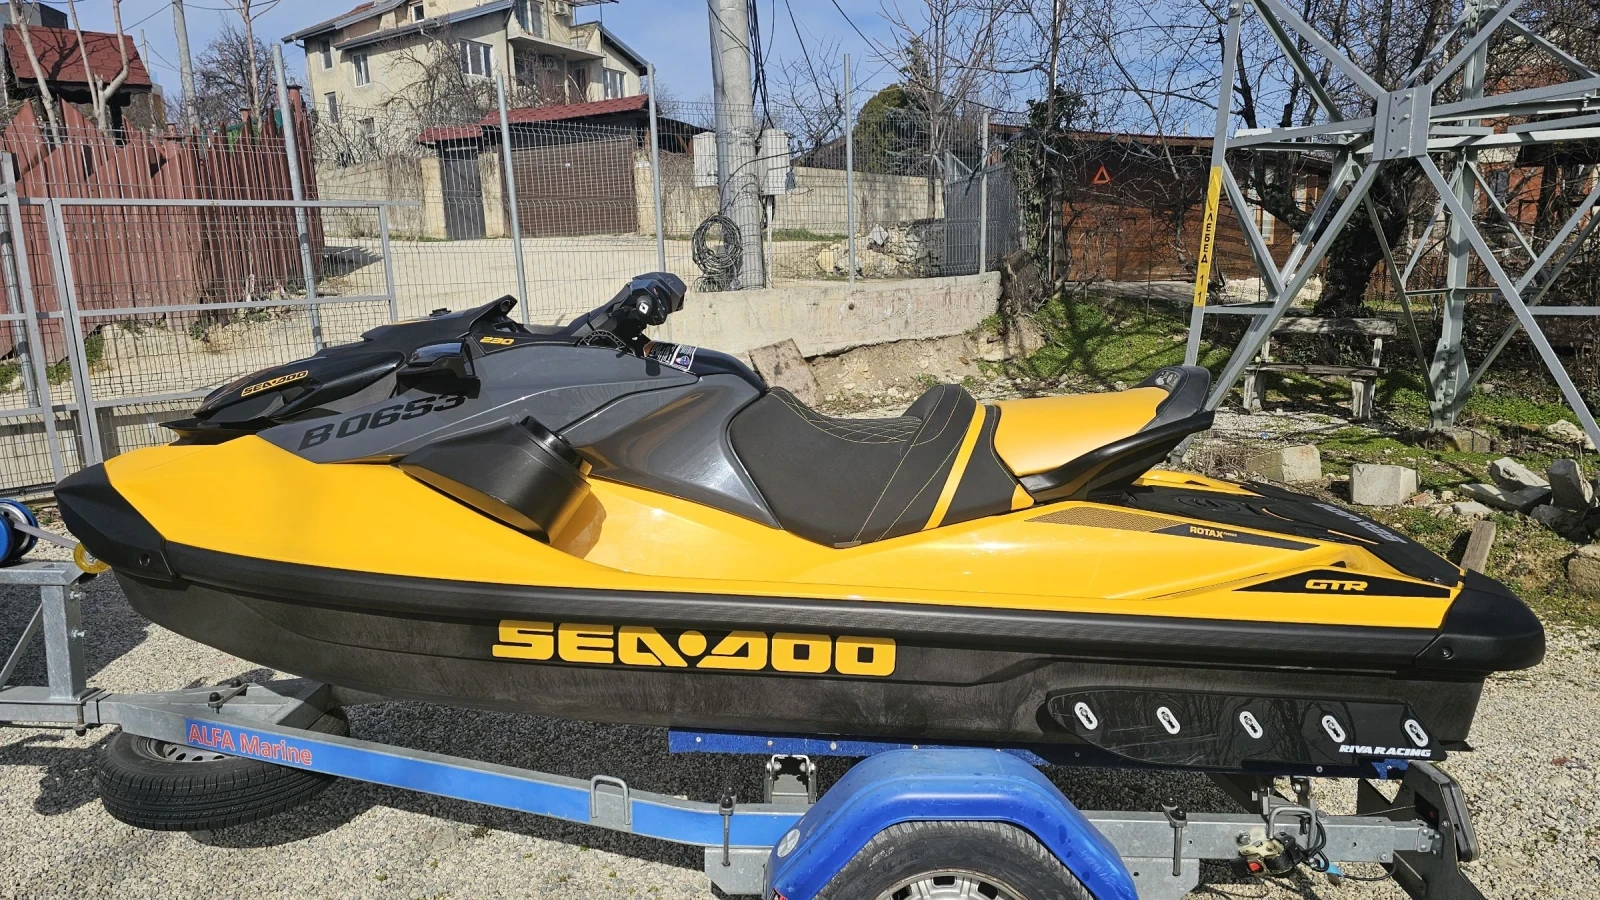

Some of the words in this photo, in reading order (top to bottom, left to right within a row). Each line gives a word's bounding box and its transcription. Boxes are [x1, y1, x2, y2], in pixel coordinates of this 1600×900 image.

[480, 336, 515, 345] 230
[1190, 526, 1223, 538] ROTAX
[1305, 579, 1368, 591] GTR
[189, 723, 235, 751] ALFA
[240, 733, 312, 765] Marine
[1339, 744, 1372, 754] RIVA
[1373, 746, 1431, 757] RACING
